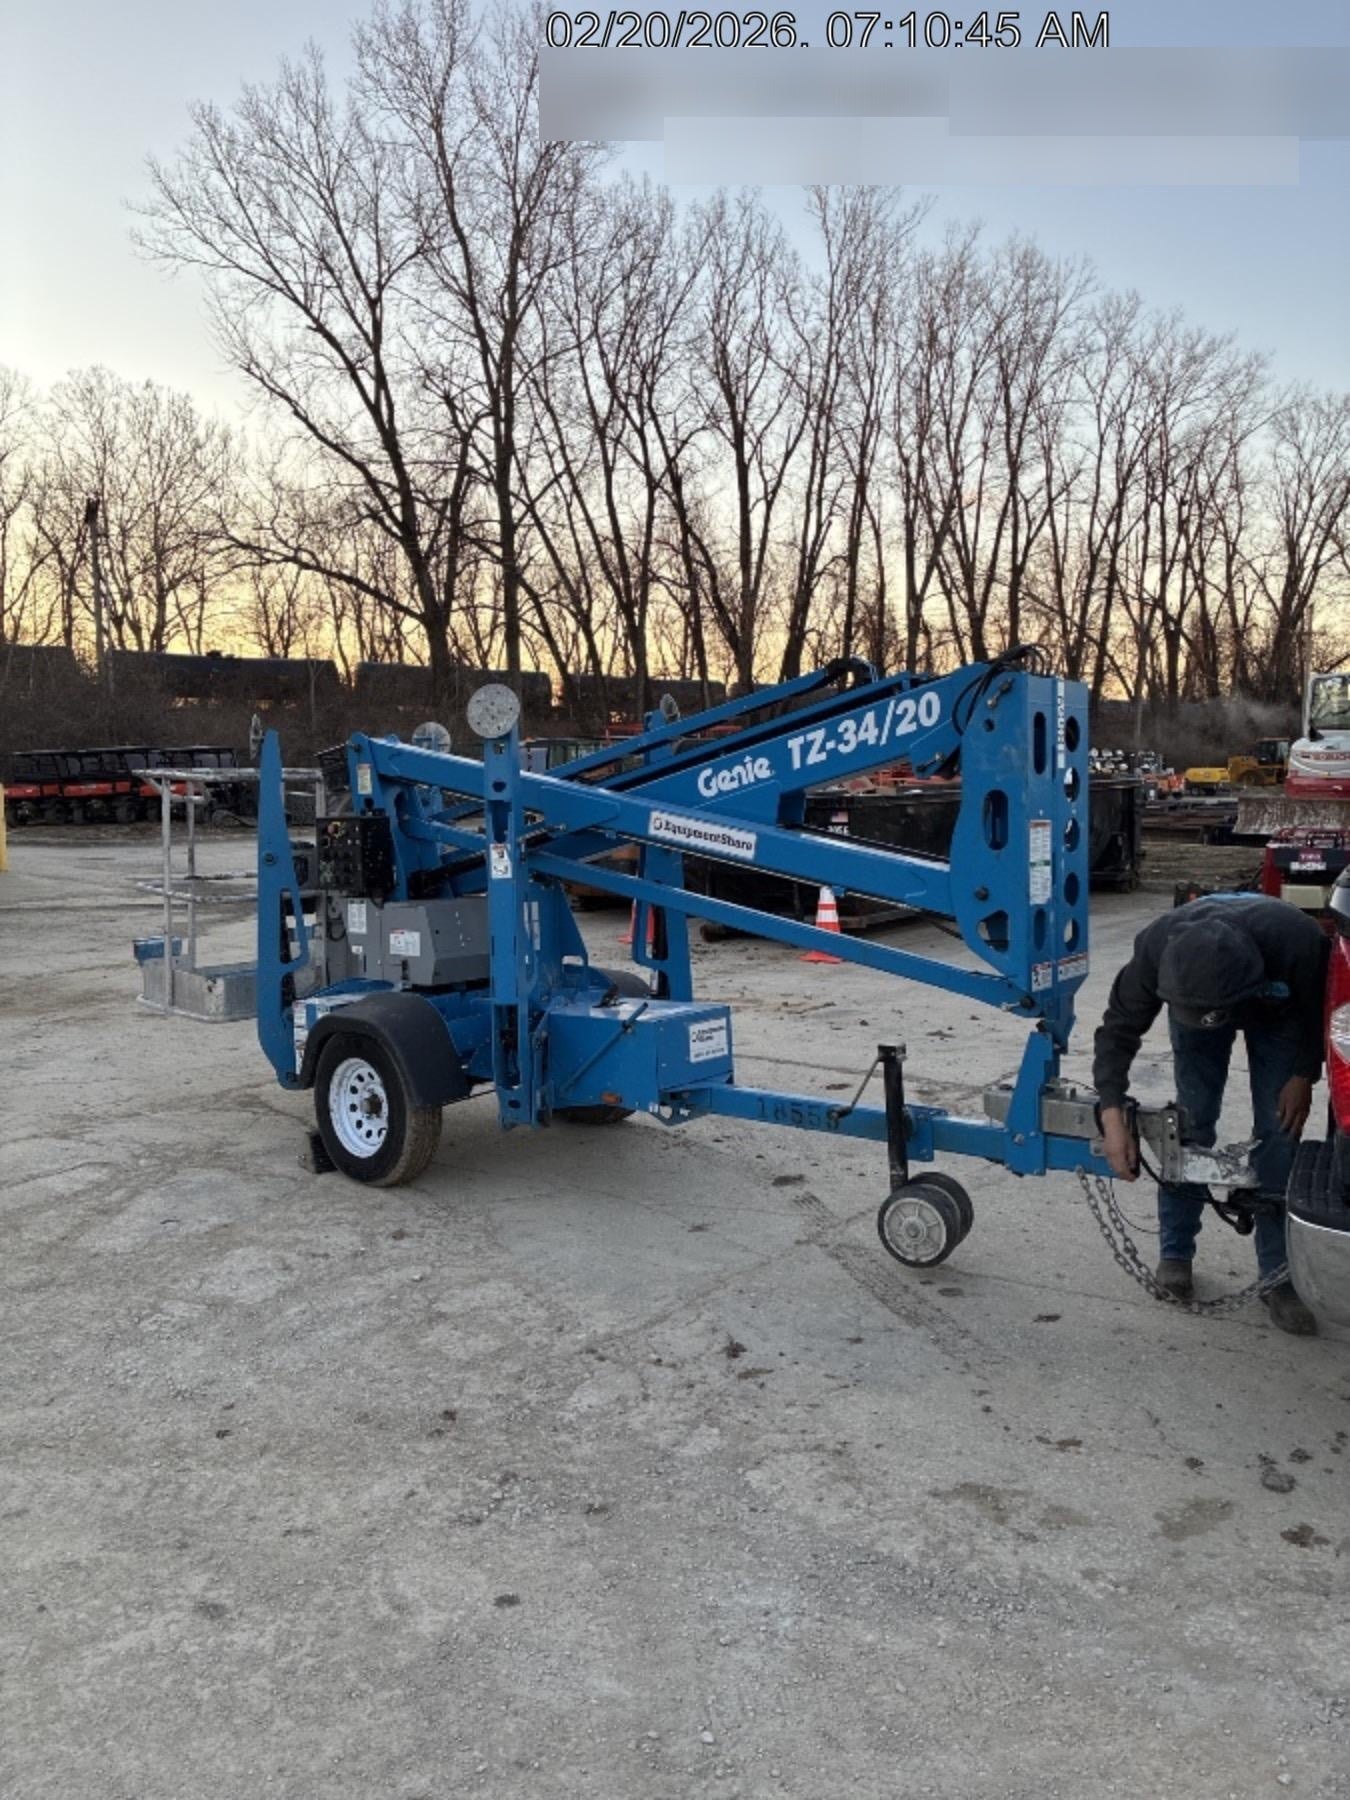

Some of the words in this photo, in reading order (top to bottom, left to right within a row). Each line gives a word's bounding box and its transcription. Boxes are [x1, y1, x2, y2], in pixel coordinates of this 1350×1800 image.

[698, 755, 771, 797] Genie
[787, 691, 942, 770] TZ-34/20
[663, 818, 753, 851] EquipmentShare
